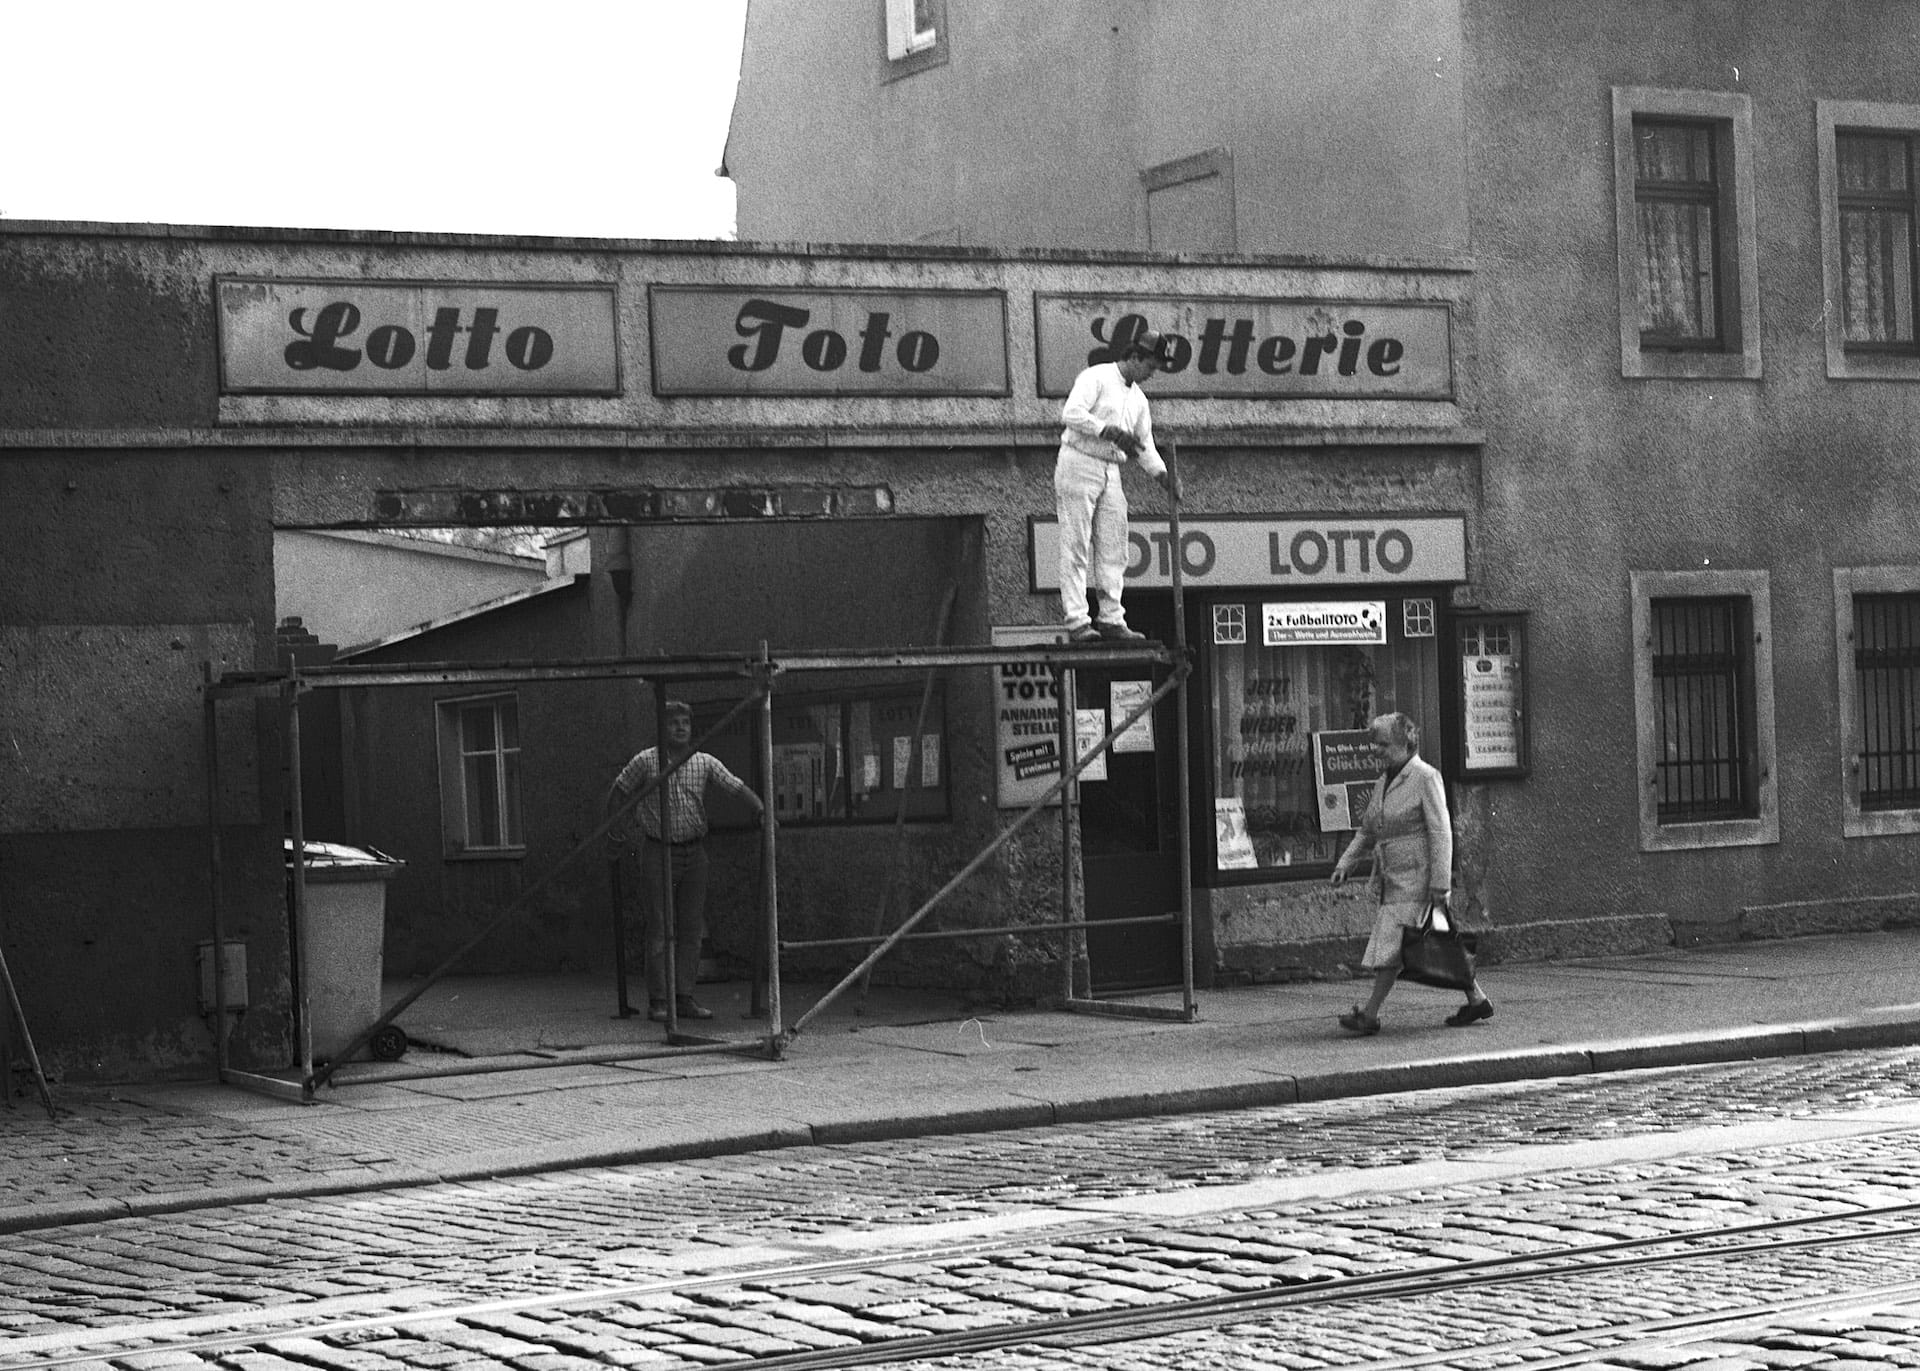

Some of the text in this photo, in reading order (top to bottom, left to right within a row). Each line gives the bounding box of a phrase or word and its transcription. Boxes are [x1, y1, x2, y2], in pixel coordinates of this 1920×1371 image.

[284, 302, 554, 371] Lotto
[727, 299, 940, 373] Toto
[1087, 313, 1404, 376] Lotterie
[1126, 528, 1413, 578] OTO LOTTO
[1246, 678, 1291, 696] JETZT
[1000, 706, 1058, 722] ANNAHM
[1240, 716, 1297, 735] WIEDER
